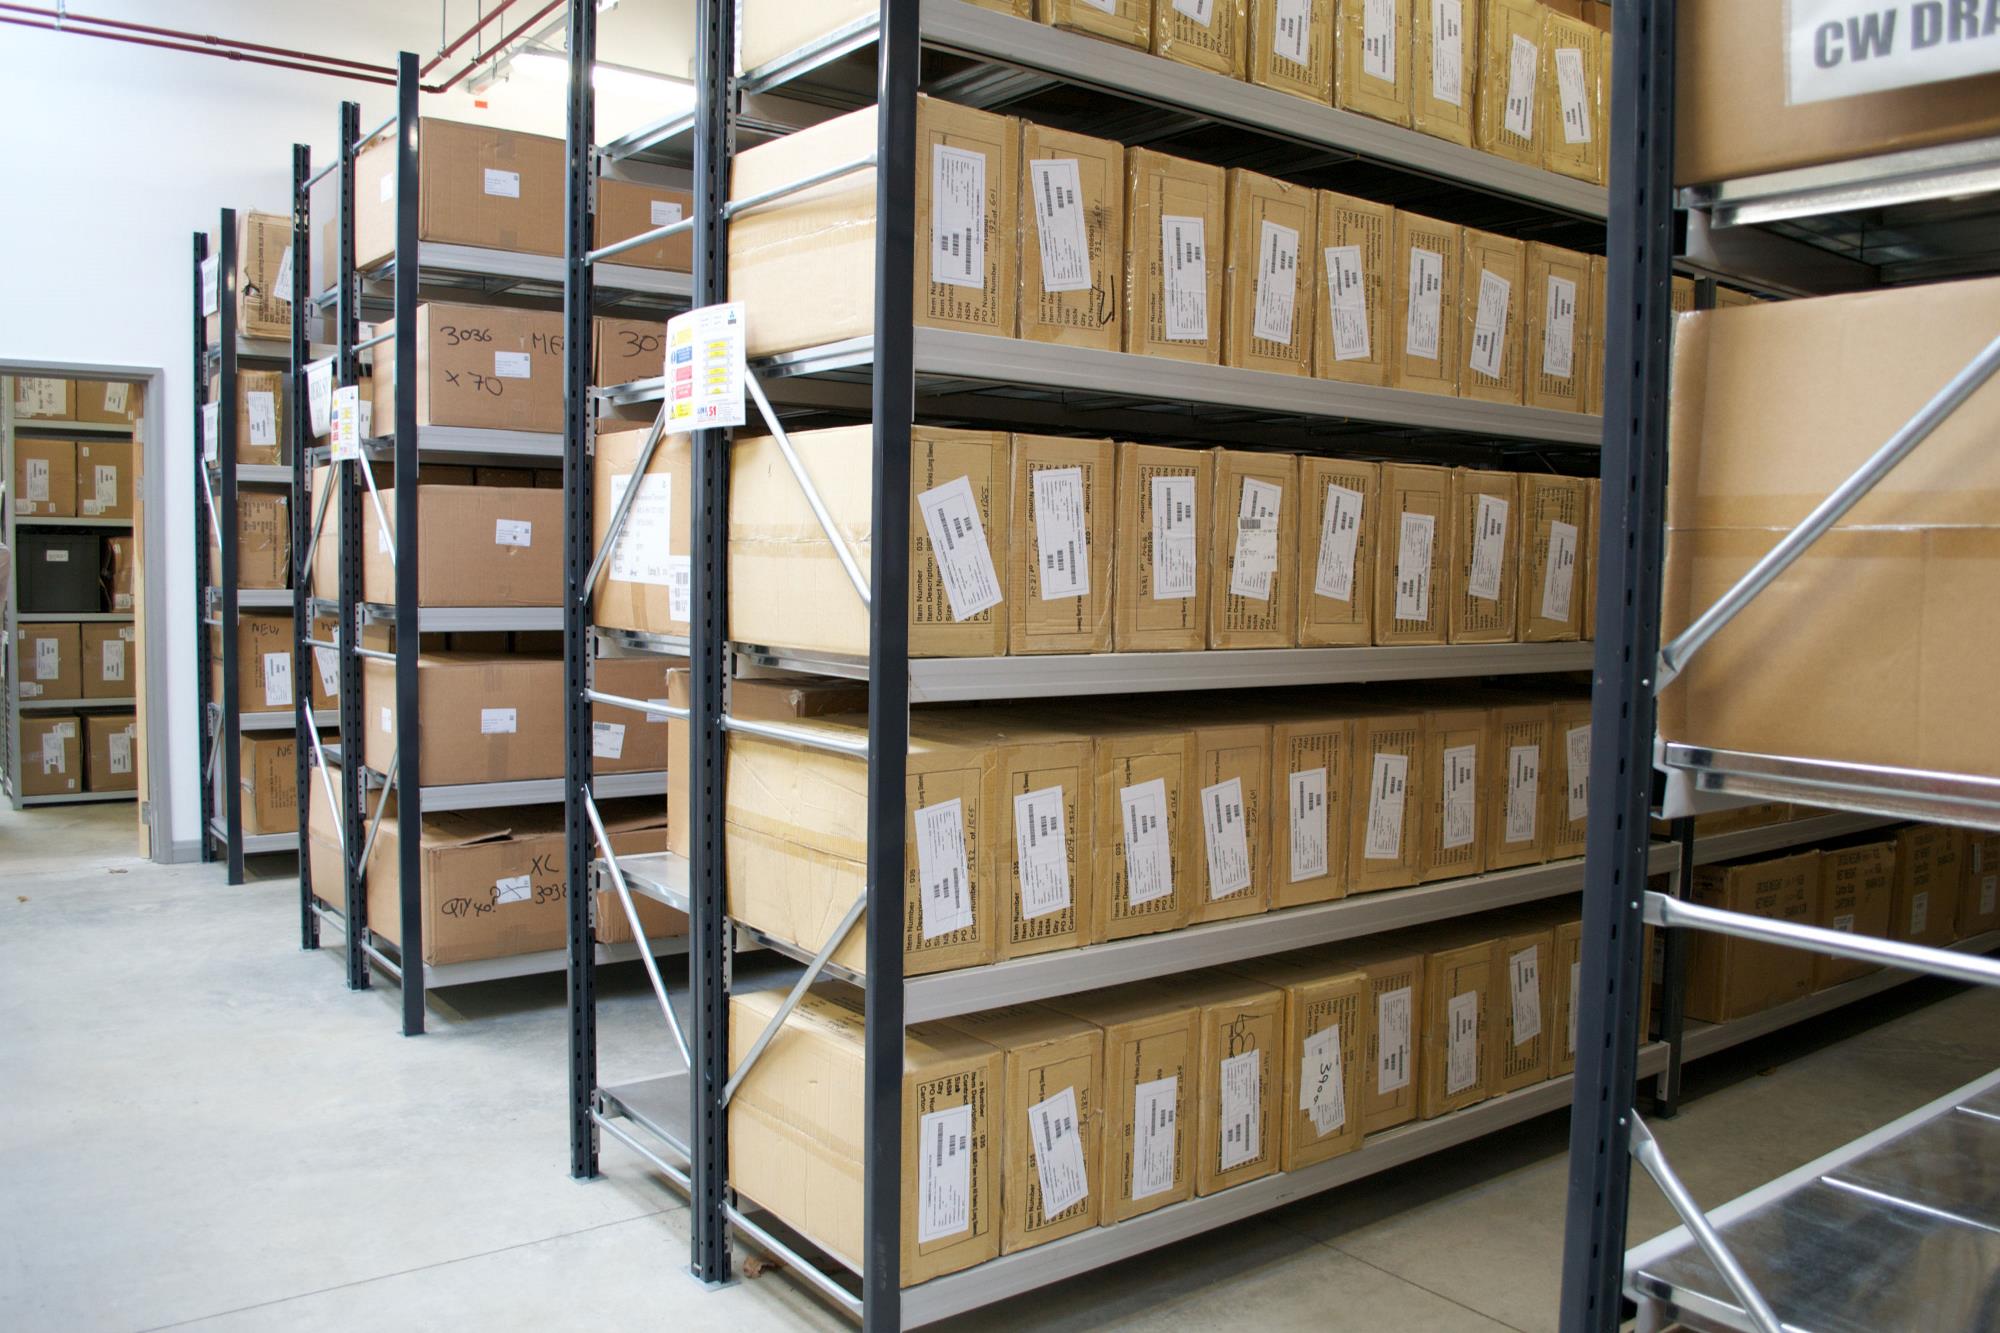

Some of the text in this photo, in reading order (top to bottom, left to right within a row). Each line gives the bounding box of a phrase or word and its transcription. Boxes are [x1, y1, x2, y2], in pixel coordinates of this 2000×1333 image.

[1814, 8, 1897, 69] CW
[440, 326, 493, 346] 3036
[467, 371, 504, 397] 70
[926, 557, 934, 602] Description
[944, 604, 952, 622] Size
[968, 832, 976, 841] of
[531, 853, 560, 877] XL
[906, 868, 916, 952] Item Number 035
[1061, 919, 1067, 933] PO
[915, 932, 923, 950] Item
[928, 1083, 936, 1097] PO
[936, 1081, 944, 1096] Qty
